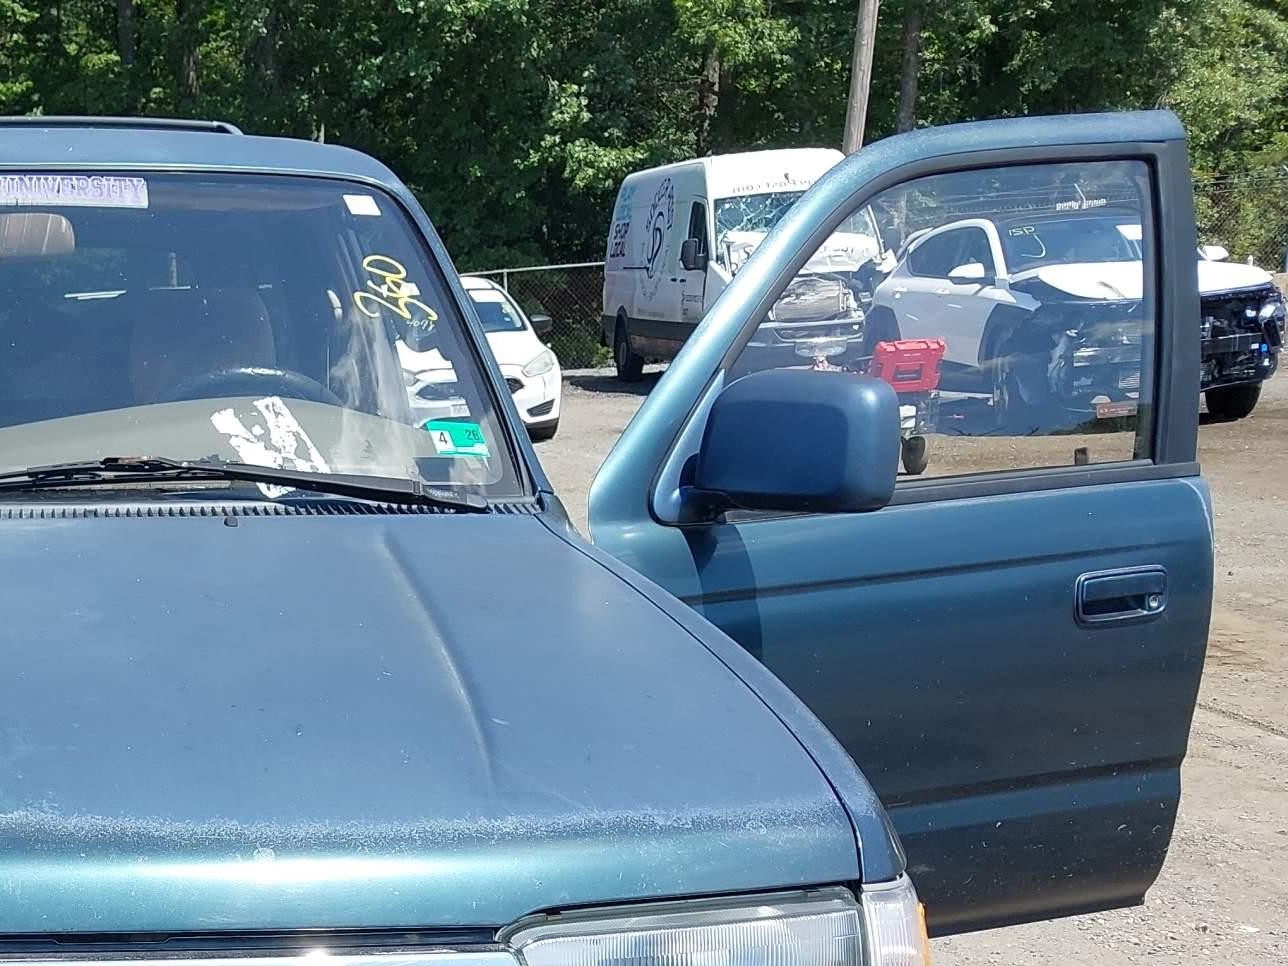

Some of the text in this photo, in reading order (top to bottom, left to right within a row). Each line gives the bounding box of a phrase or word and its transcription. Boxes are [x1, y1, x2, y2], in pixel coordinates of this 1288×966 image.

[0, 176, 146, 200] UNIVERSITY
[439, 431, 448, 445] 4
[464, 428, 481, 441] 26
